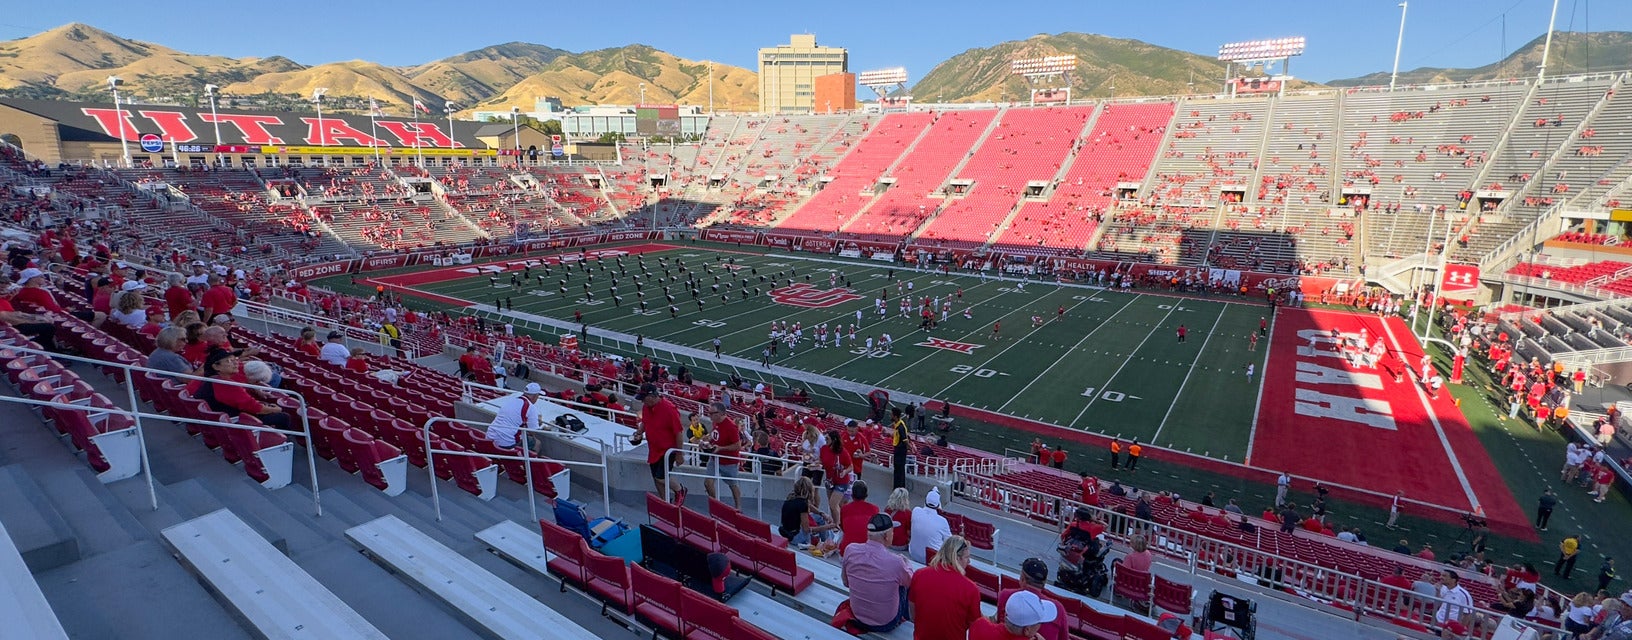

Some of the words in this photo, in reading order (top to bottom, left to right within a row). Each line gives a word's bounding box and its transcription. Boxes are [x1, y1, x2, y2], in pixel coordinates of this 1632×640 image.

[81, 107, 465, 148] UTAH
[532, 242, 546, 250] RED
[369, 257, 398, 267] UFIRST
[1067, 262, 1096, 270] HEALTH
[299, 269, 314, 278] RED
[315, 264, 342, 275] ZONE
[692, 318, 728, 329] 50
[850, 346, 892, 358] 30
[949, 364, 997, 378] 20
[1080, 387, 1126, 402] 10
[1088, 485, 1096, 495] 11
